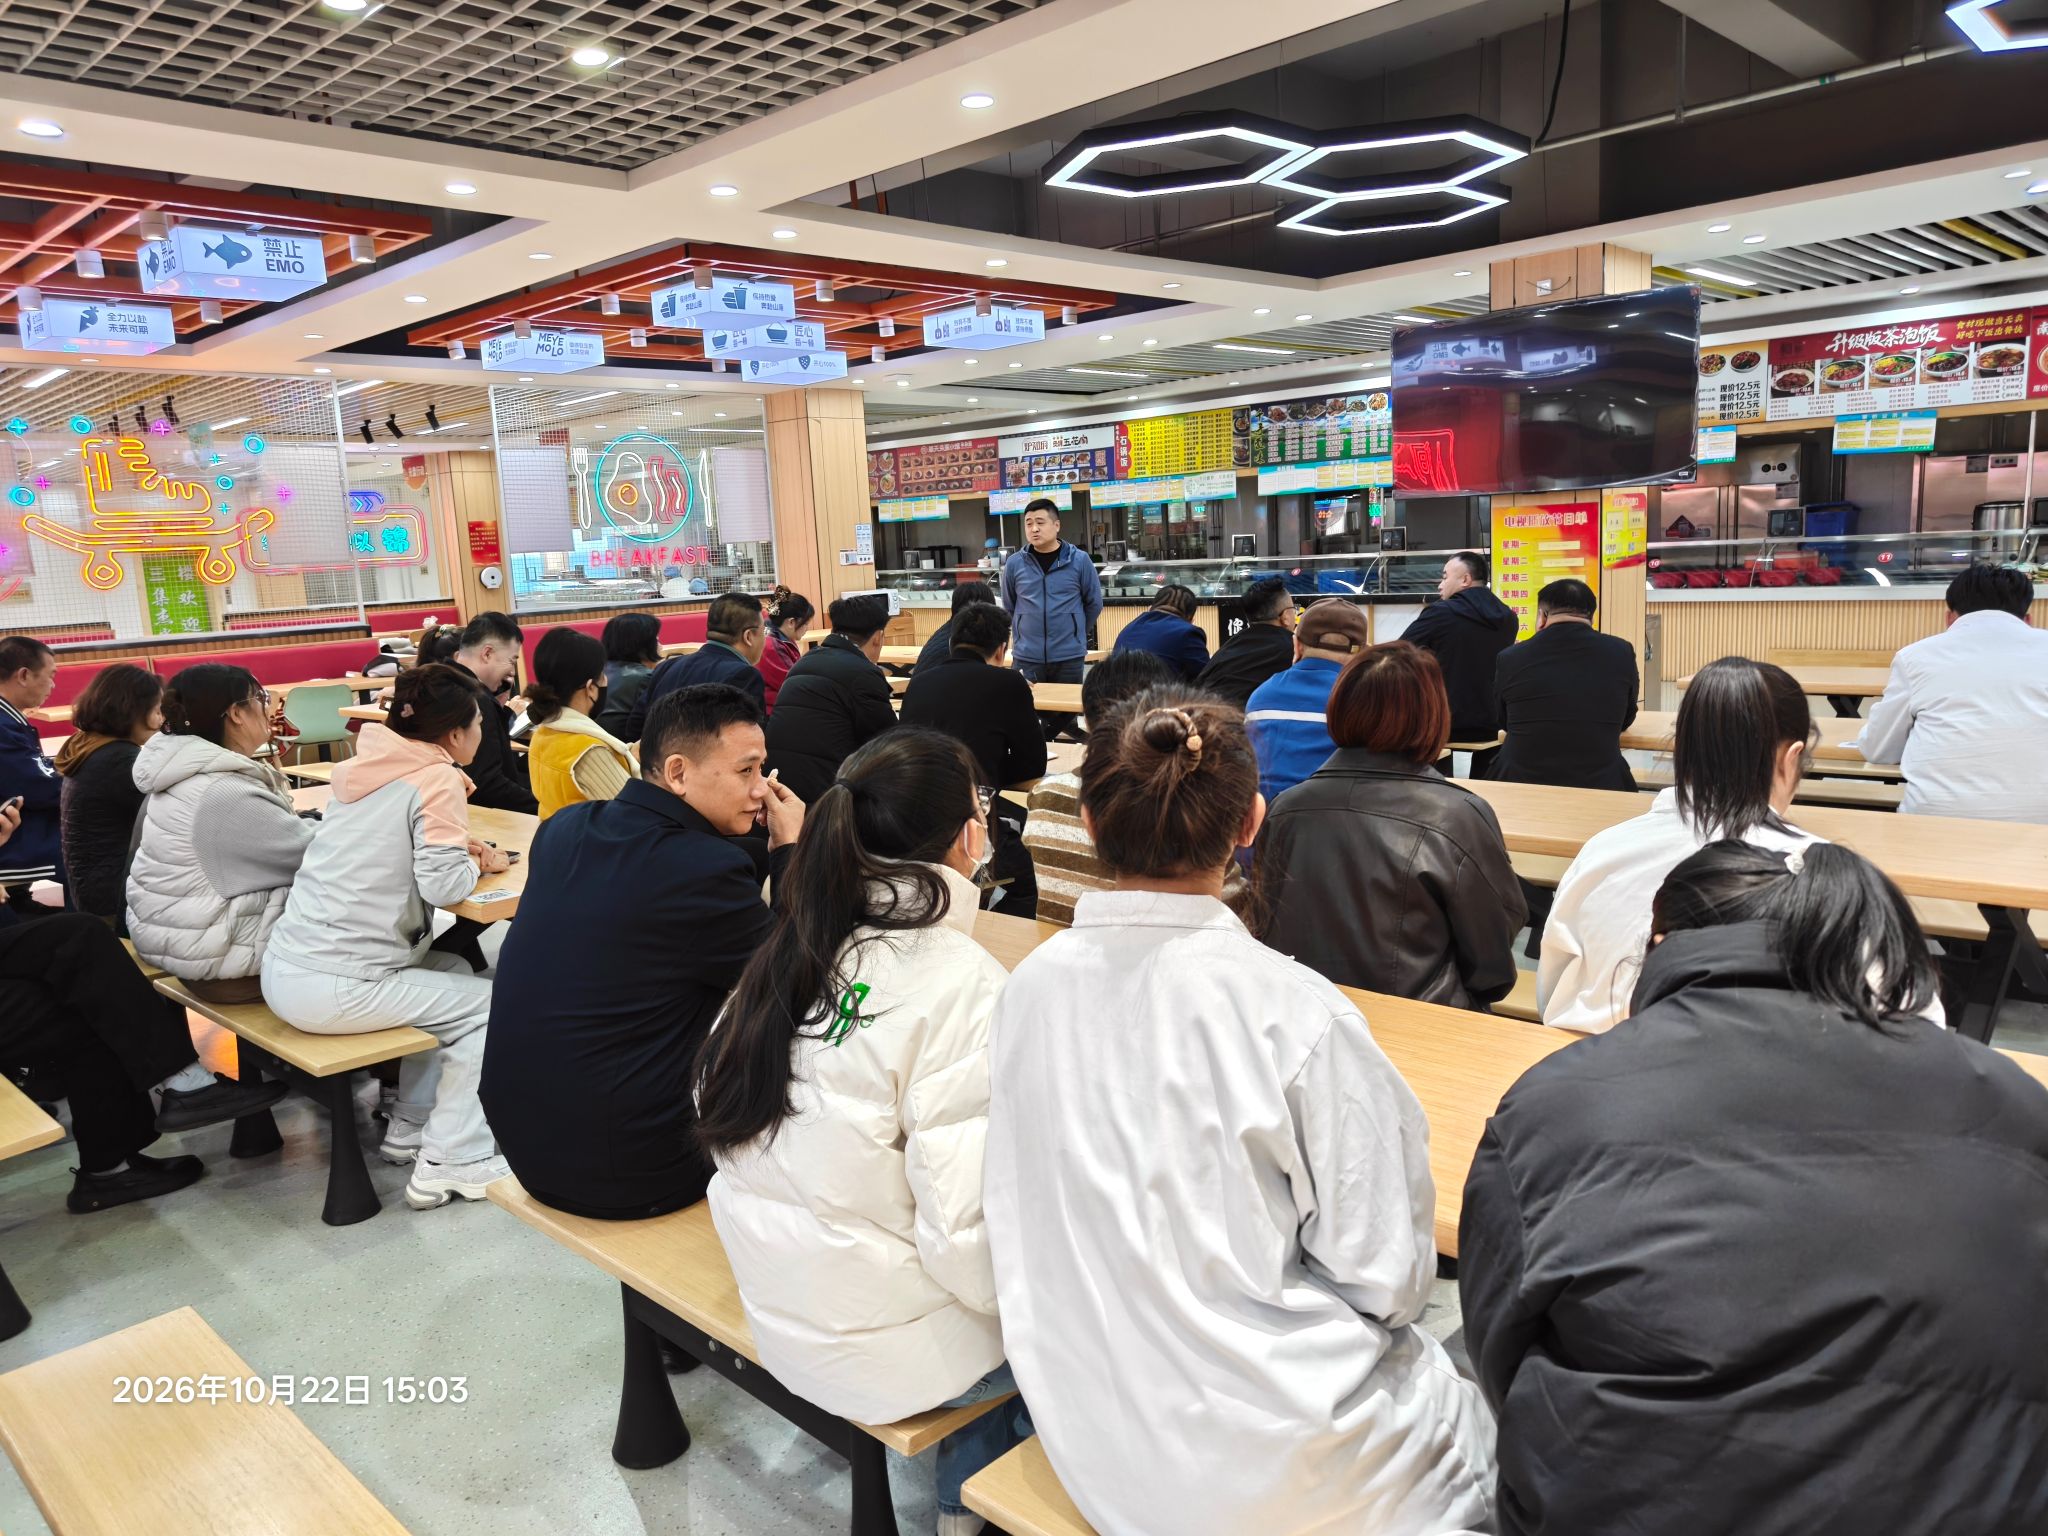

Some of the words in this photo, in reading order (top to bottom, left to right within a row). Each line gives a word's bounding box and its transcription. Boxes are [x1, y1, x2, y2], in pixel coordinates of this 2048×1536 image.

[263, 237, 304, 260] 禁止
[163, 256, 177, 274] EMO
[265, 258, 305, 275] EMO
[107, 312, 148, 324] 全力以赴
[108, 323, 149, 335] 未来可期
[794, 324, 814, 338] 匠心
[538, 332, 564, 347] MEYE
[1825, 323, 1946, 356] 升级版茶泡饭
[535, 343, 564, 357] MOLO
[1503, 540, 1529, 549] 星期一
[590, 545, 709, 568] BREAKFAST
[1503, 556, 1529, 565] 星期二
[1503, 573, 1529, 582] 星期三
[1503, 590, 1529, 598] 星期四
